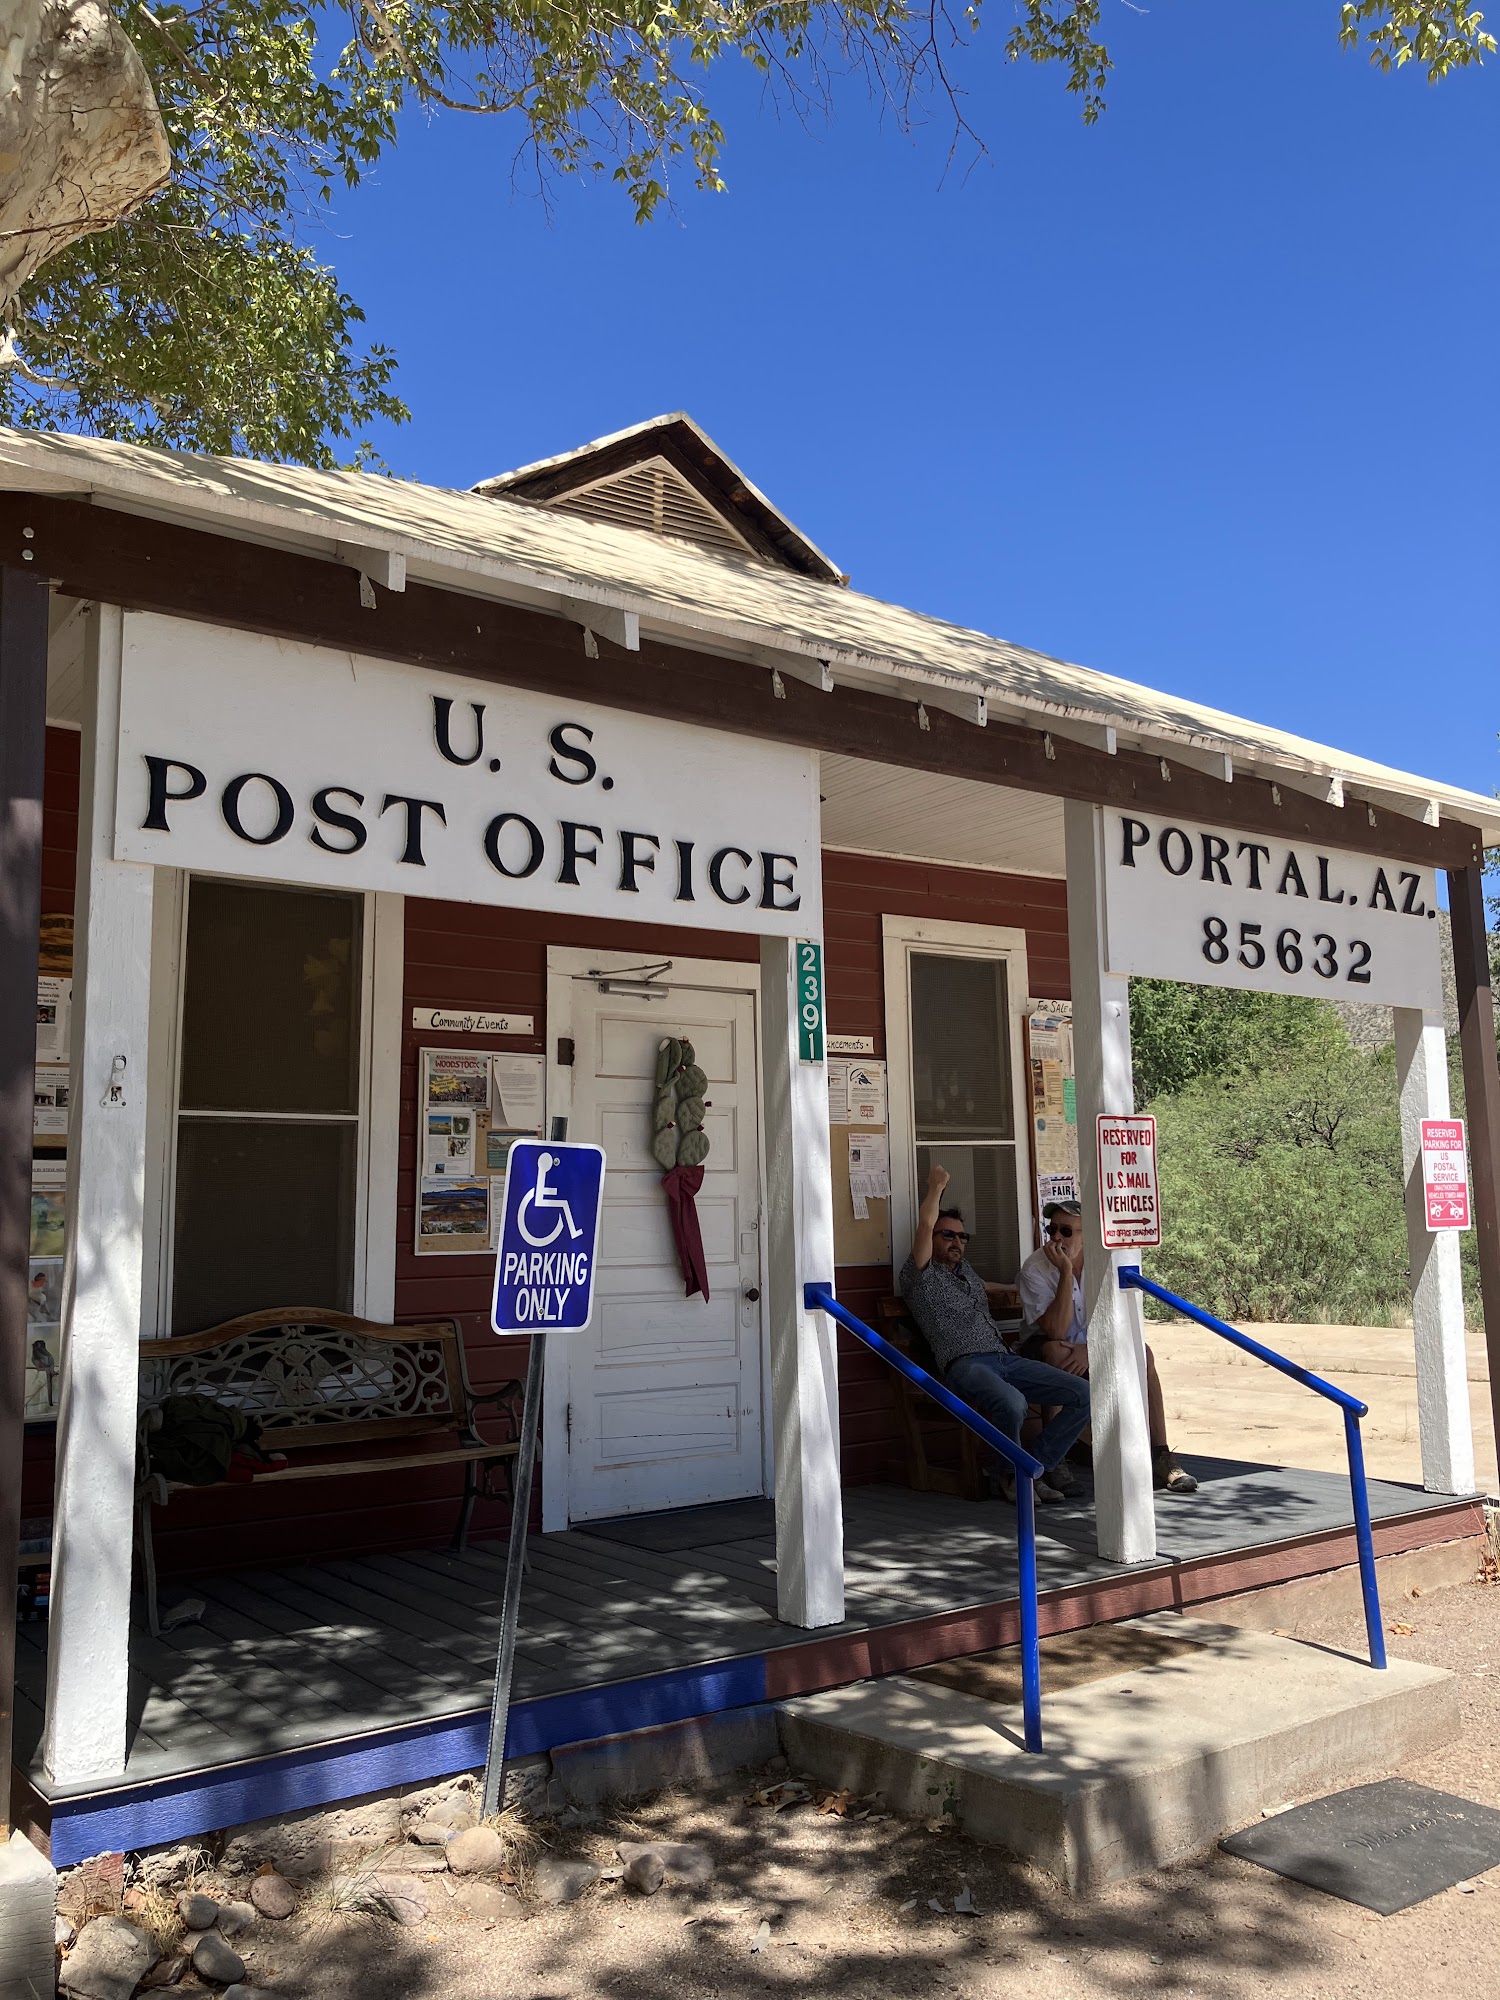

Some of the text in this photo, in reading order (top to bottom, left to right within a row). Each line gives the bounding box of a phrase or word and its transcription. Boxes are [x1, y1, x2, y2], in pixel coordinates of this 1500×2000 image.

[432, 695, 614, 791] U. S.
[140, 755, 802, 912] POST OFFICE
[1202, 916, 1372, 984] 85632
[801, 946, 820, 1060] 2391
[1049, 1000, 1069, 1014] SALE
[430, 1011, 509, 1032] Community Events
[435, 1060, 480, 1069] WOODSTOCK
[1102, 1128, 1151, 1146] RESERVED
[1427, 1128, 1457, 1138] RESERVED
[1424, 1139, 1462, 1149] PARKING FOR
[1120, 1151, 1138, 1166] FOR
[1440, 1152, 1449, 1160] US
[1433, 1162, 1457, 1171] POSTAL
[1433, 1173, 1459, 1181] SERVICE
[1052, 1185, 1071, 1196] FAIR
[1106, 1194, 1154, 1213] VEHICLES
[503, 1252, 589, 1286] PARKING
[515, 1287, 572, 1322] ONLY
